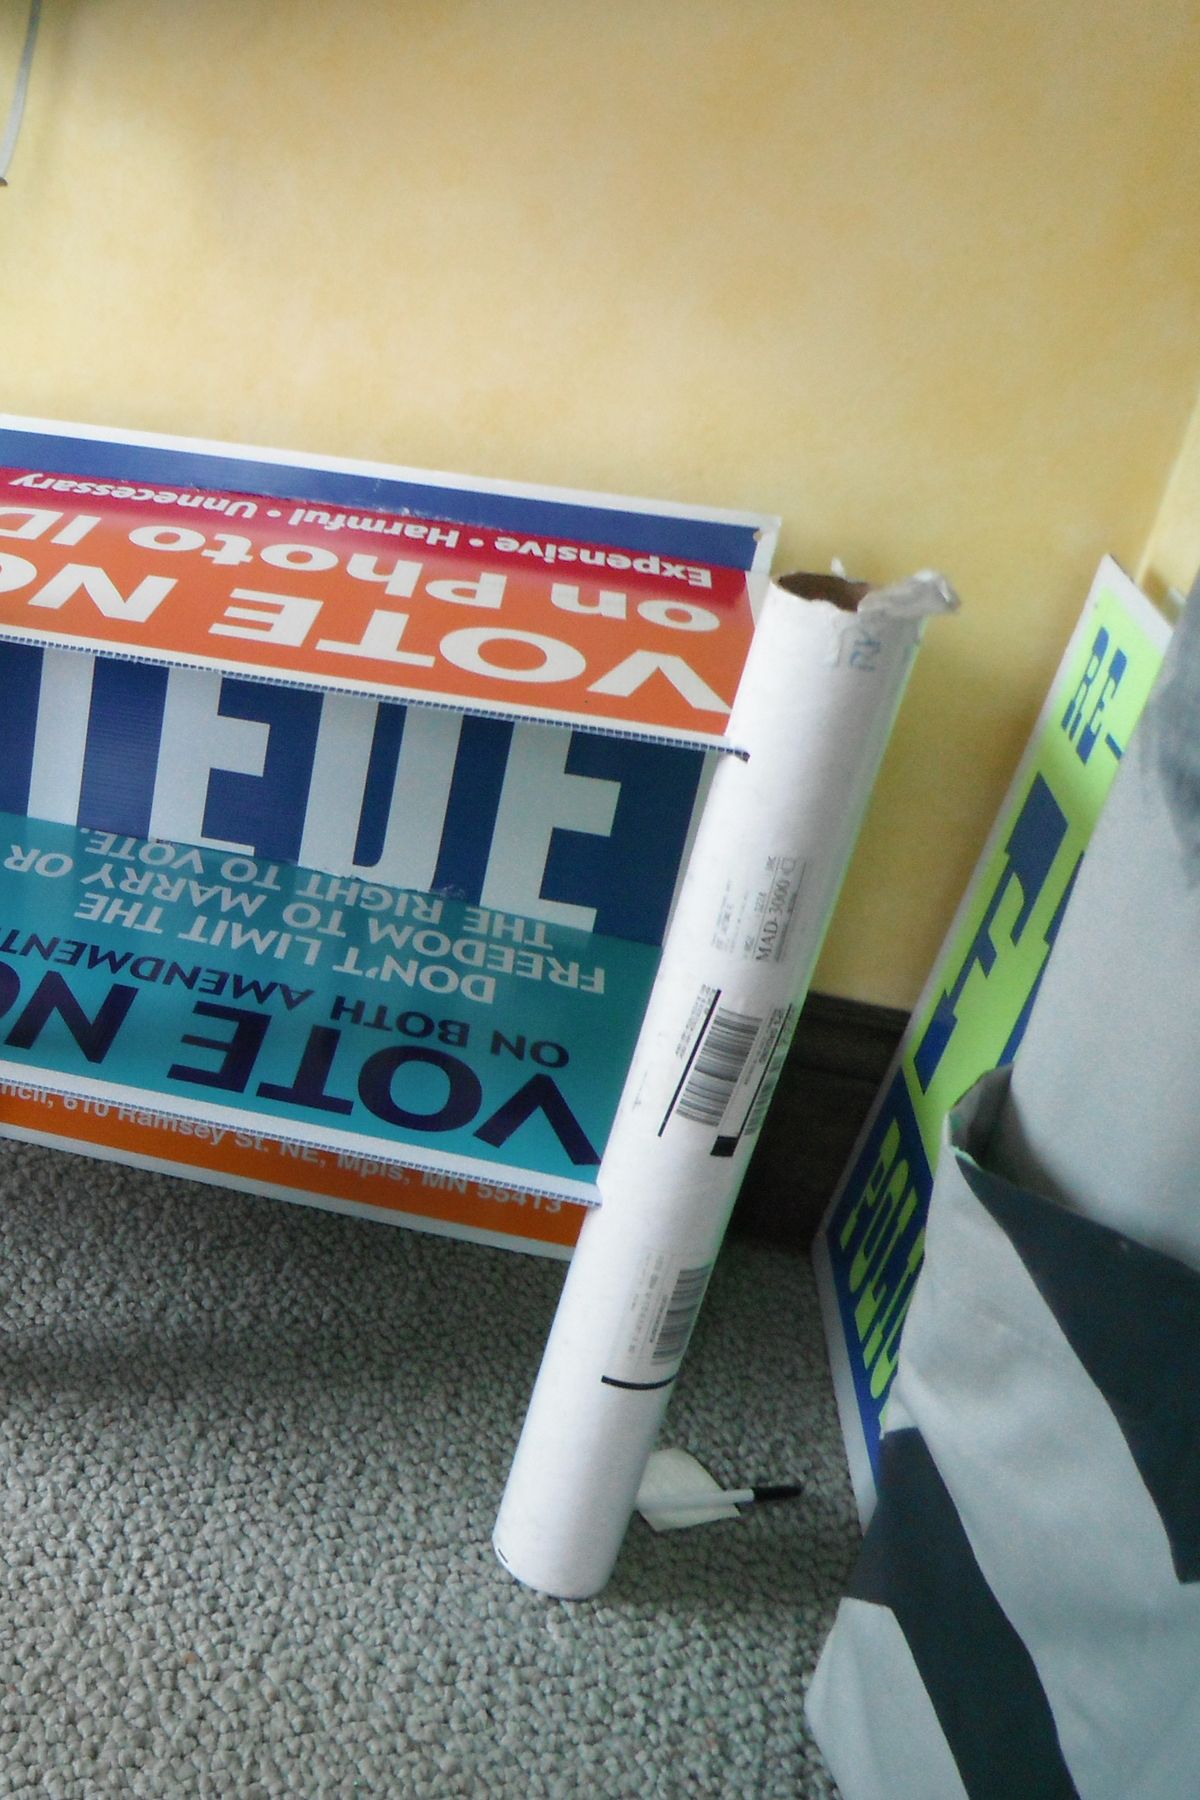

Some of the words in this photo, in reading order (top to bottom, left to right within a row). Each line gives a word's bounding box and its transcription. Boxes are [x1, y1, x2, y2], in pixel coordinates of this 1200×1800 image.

[9, 471, 257, 518] Unnecessary
[289, 509, 460, 549] Harmful
[128, 524, 503, 609] Photo
[494, 537, 714, 589] Expensive
[550, 582, 720, 632] on
[208, 587, 733, 715] VOTE
[1, 843, 75, 879] OR
[219, 855, 279, 889] TO
[75, 892, 165, 934] THE
[80, 862, 267, 921] MARRY
[302, 882, 444, 925] RIGHT
[178, 915, 317, 968] LIMIT
[282, 901, 358, 934] TO
[464, 908, 555, 952] THE
[334, 945, 495, 1005] DON'T
[366, 917, 606, 996] FREEDOM
[331, 995, 469, 1048] BOTH
[491, 1031, 570, 1068] ON
[167, 1002, 601, 1166] VOTE
